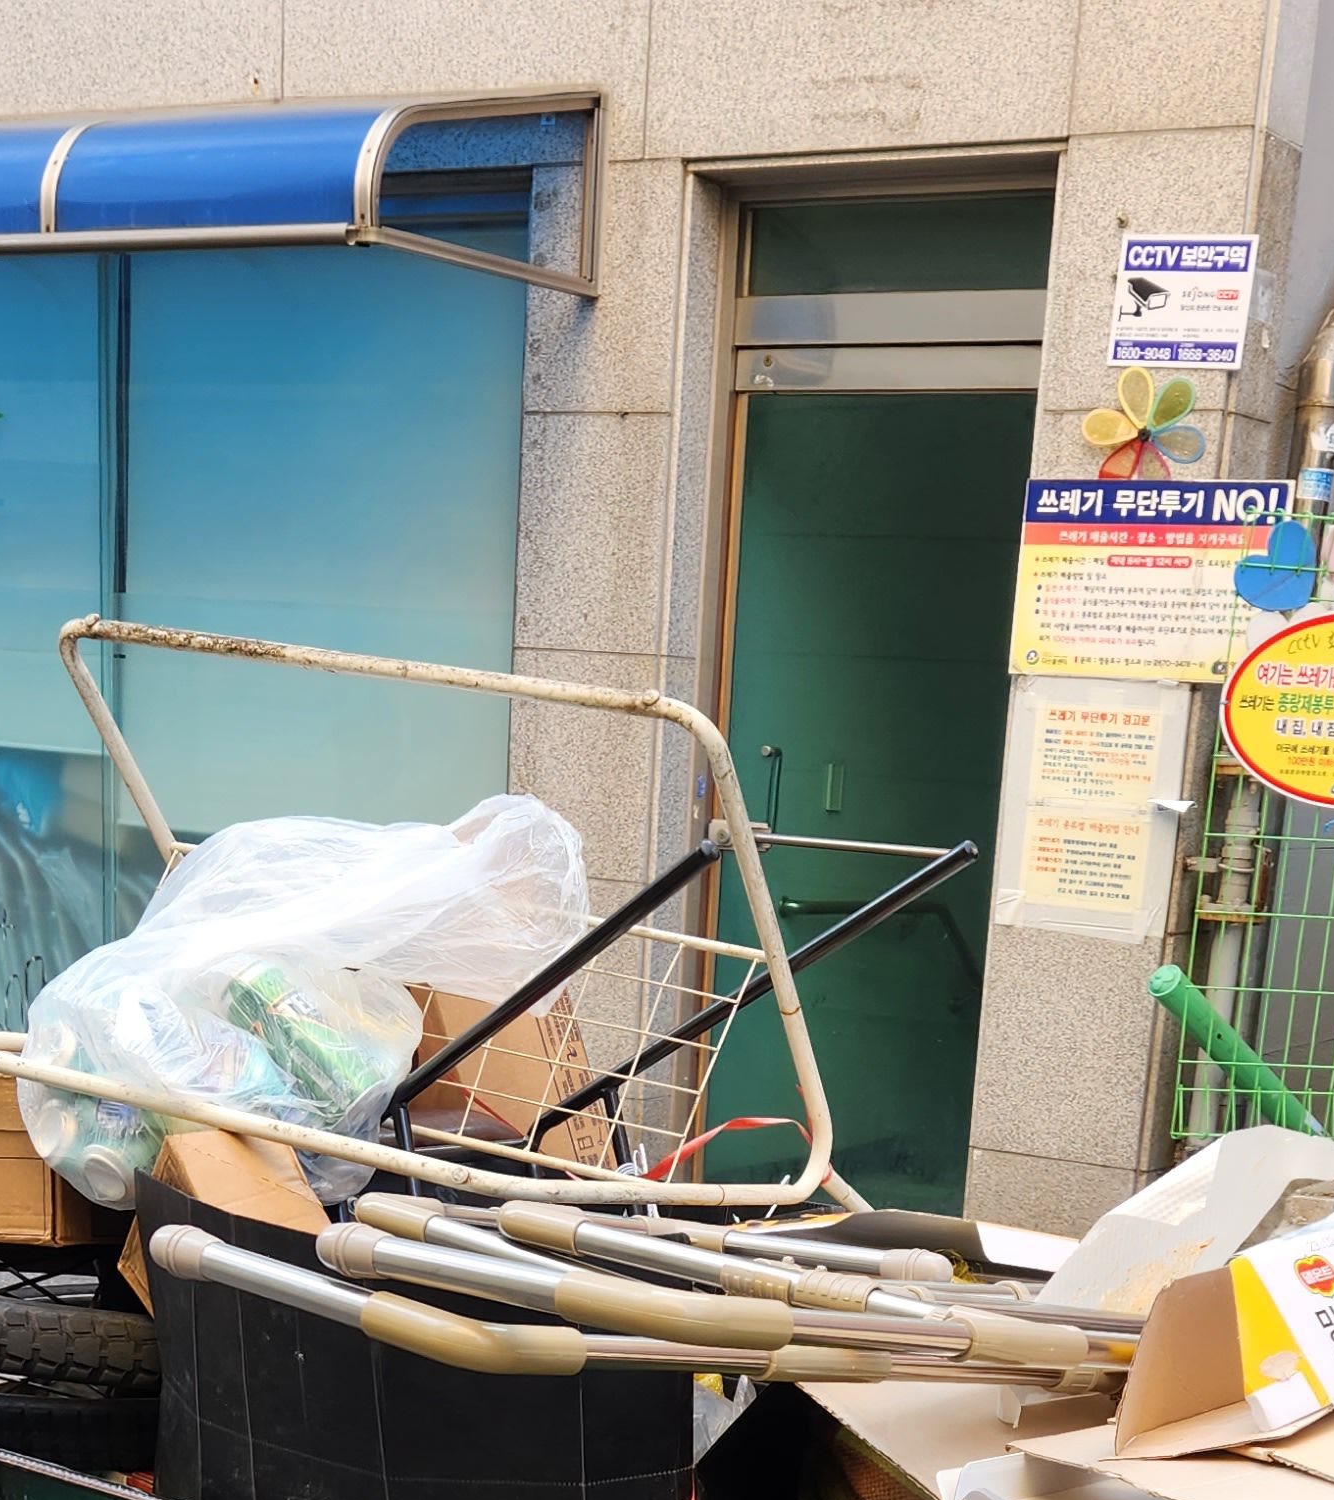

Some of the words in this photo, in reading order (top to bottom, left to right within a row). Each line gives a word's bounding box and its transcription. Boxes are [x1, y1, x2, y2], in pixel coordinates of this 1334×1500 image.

[1128, 245, 1181, 267] CCTV
[1179, 245, 1248, 269] 보안구역
[1116, 346, 1172, 360] 1600-9048
[1177, 347, 1235, 362] 1668-3640
[1036, 488, 1103, 517] 쓰레기
[1112, 489, 1206, 519] 무단투기
[1212, 487, 1281, 524] NO!
[1257, 663, 1294, 687] 여기는
[1239, 694, 1276, 712] 쓰레기는
[1047, 709, 1077, 722] 쓰레기
[1081, 711, 1119, 725] 무단투기
[1122, 713, 1151, 727] 경고문
[1276, 718, 1288, 735] 내
[1292, 719, 1307, 736] 집,
[1311, 720, 1324, 737] 내
